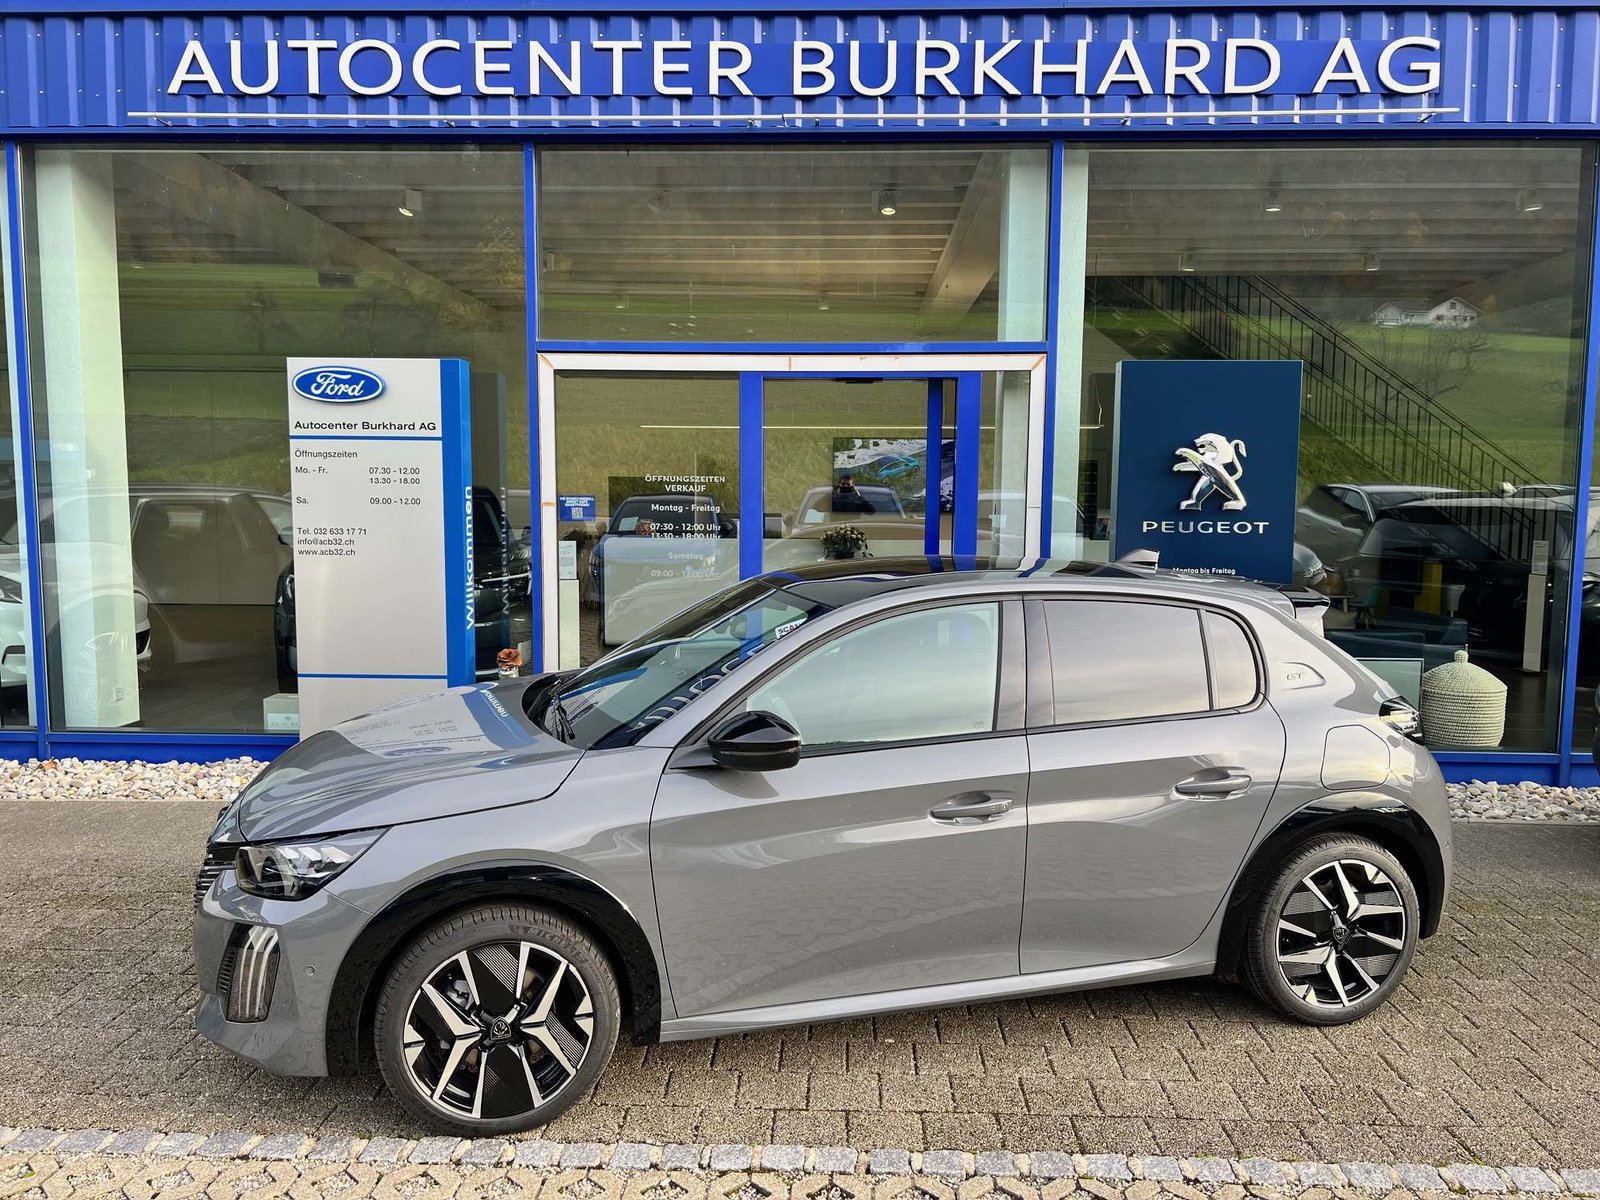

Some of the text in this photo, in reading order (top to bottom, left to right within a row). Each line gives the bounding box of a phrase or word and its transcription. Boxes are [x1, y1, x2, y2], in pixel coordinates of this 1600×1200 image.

[168, 36, 1442, 98] AUTOCENTER BURKHARD AG
[310, 372, 366, 397] Ford
[294, 421, 437, 431] Autocenter Burkhard AG
[294, 448, 358, 459] Öffnungszeiten
[295, 466, 311, 474] Mo.
[318, 466, 328, 474] Fr.
[369, 467, 391, 475] 07.30
[399, 467, 420, 475] 12.00
[370, 477, 392, 485] 13.30
[399, 477, 421, 485] 18.00
[644, 474, 726, 483] ÖFFNUNGSZEITEN
[665, 484, 706, 492] VERKAUF
[296, 496, 309, 504] Sa.
[370, 497, 392, 505] 09.00
[399, 497, 421, 505] 12.00
[651, 503, 683, 513] Montag
[691, 504, 721, 514] Freitag
[297, 527, 312, 535] Tel.
[313, 527, 328, 535] 032
[329, 527, 344, 535] 633
[650, 523, 674, 531] 07:30
[681, 523, 705, 531] 12:00
[706, 523, 721, 531] Uhr
[1142, 521, 1270, 534] PEUGEOT
[650, 532, 674, 540] 13:30
[681, 532, 705, 540] 18:00
[297, 538, 355, 546] info@acb32.ch
[298, 548, 356, 556] www.acb32.ch
[464, 486, 475, 631] Willkommen
[1211, 567, 1236, 576] Freitag
